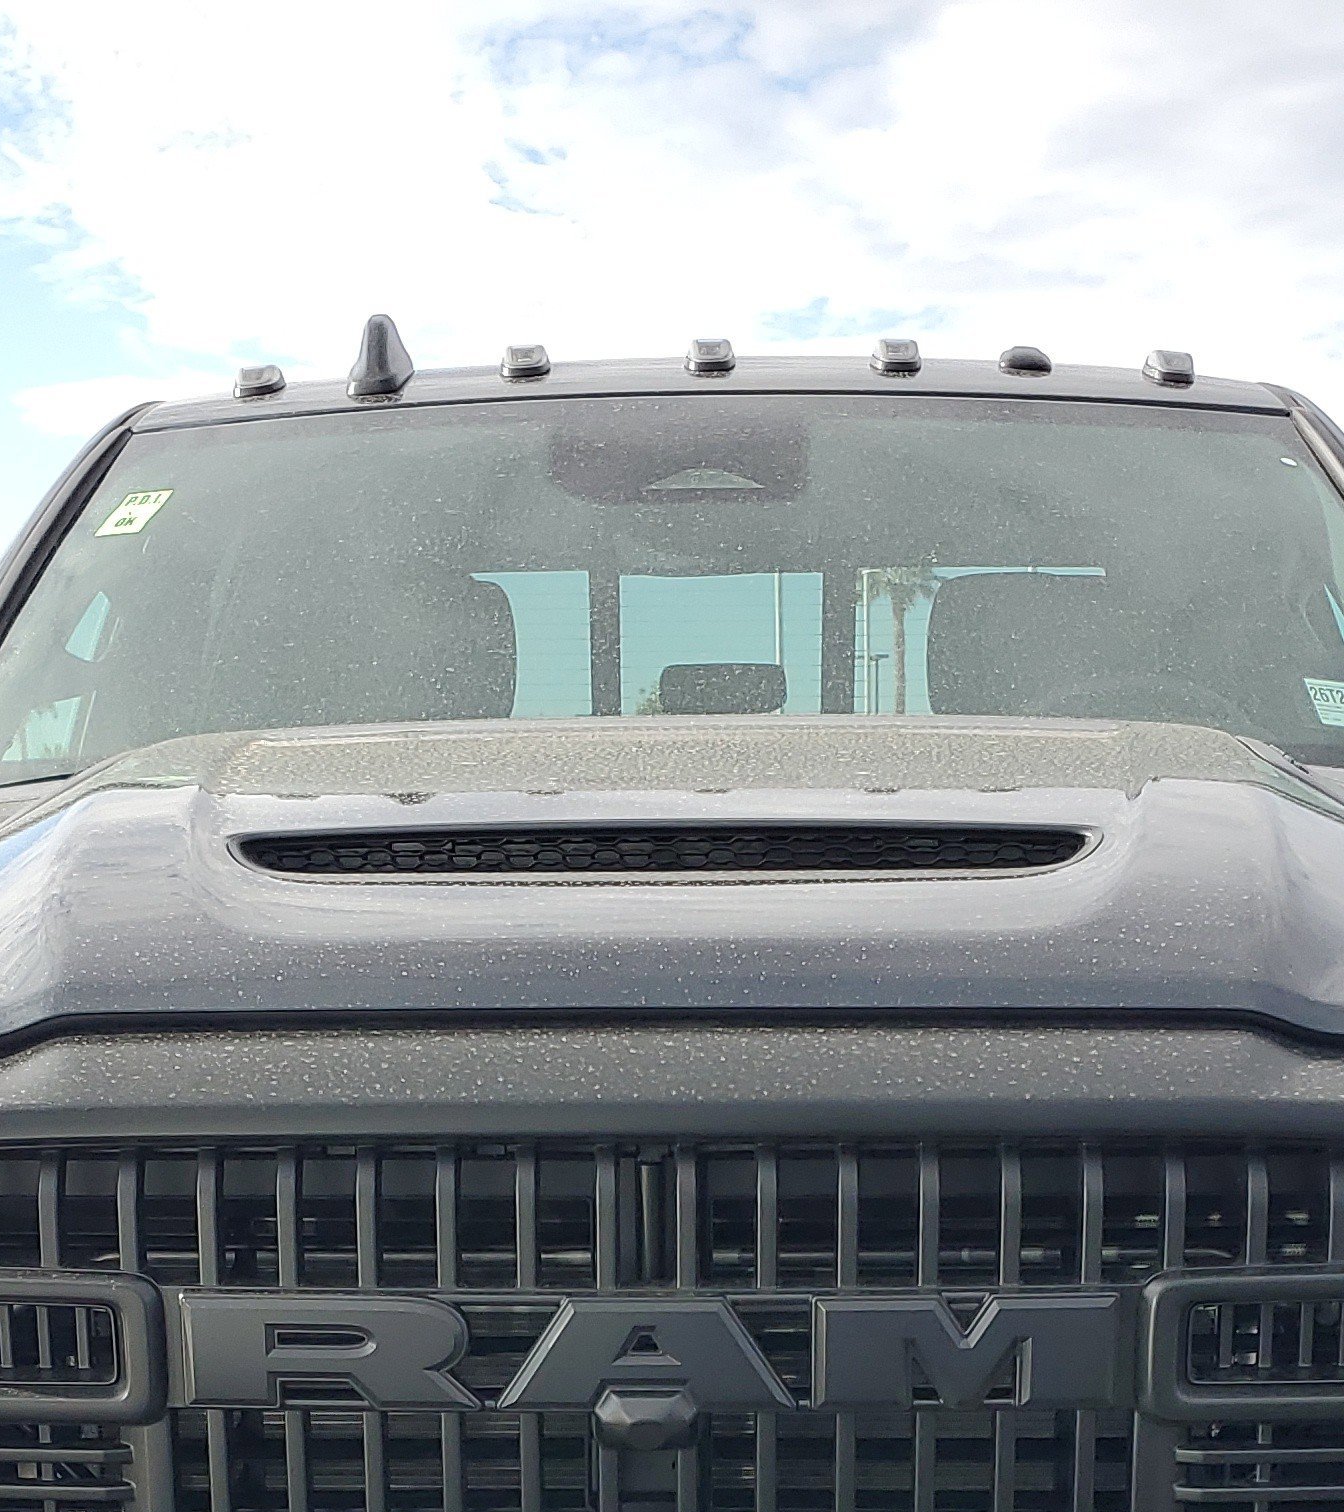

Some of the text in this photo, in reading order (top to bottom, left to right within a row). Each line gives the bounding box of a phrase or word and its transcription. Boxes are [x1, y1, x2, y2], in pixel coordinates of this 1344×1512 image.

[124, 493, 162, 506] P.D.I.
[114, 516, 138, 528] OK
[178, 1291, 1120, 1412] RAM
